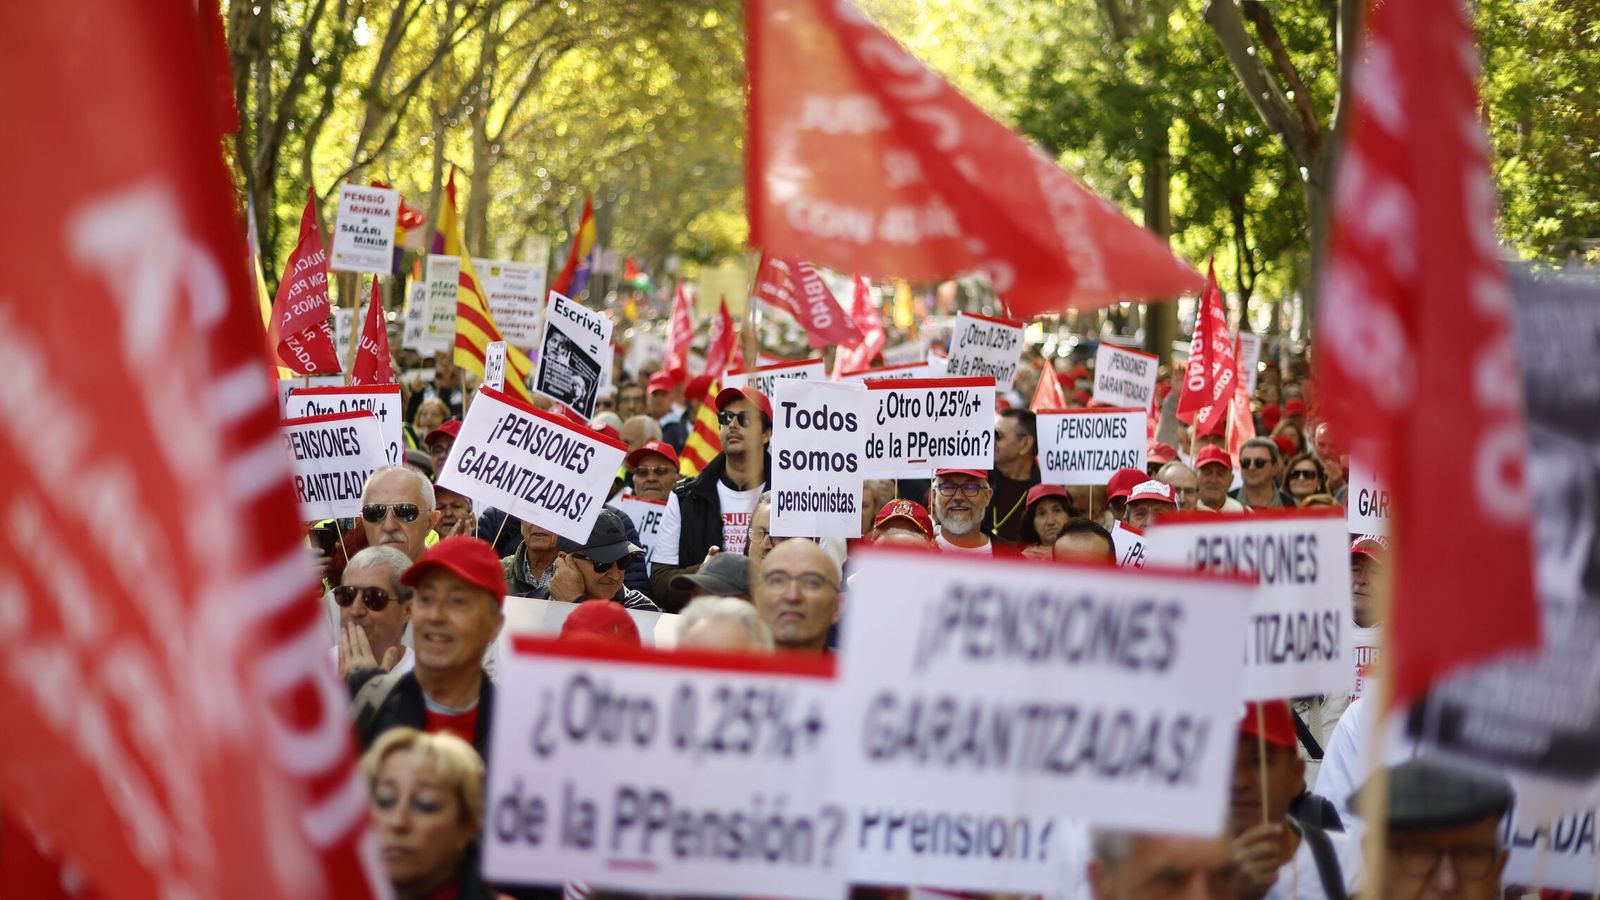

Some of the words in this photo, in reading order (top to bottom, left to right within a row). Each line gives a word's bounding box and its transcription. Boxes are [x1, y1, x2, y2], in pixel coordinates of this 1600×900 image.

[960, 324, 986, 348] ¿Otro
[947, 354, 959, 374] de
[960, 355, 970, 375] la
[781, 402, 858, 432] Todos
[876, 392, 921, 425] ¿Otro
[926, 390, 981, 422] 0,25%+
[487, 412, 595, 474] ¡PENSIONES
[865, 433, 884, 459] de
[889, 432, 901, 458] la
[907, 430, 991, 458] PPensión?
[1056, 418, 1127, 444] ¡PENSIONES
[778, 449, 858, 473] somos
[1046, 450, 1139, 471] GARANTIZADAS!
[457, 445, 592, 522] GARANTIZADAS!
[777, 485, 856, 517] pensionistas.
[914, 581, 1183, 676] ¡PENSIONES
[531, 669, 658, 760] ¿Otro
[672, 682, 824, 766] 0,25%+
[863, 689, 1211, 787] GARANTIZADAS!
[497, 777, 546, 846] de
[560, 780, 596, 849] la
[611, 786, 846, 868] PPensión?
